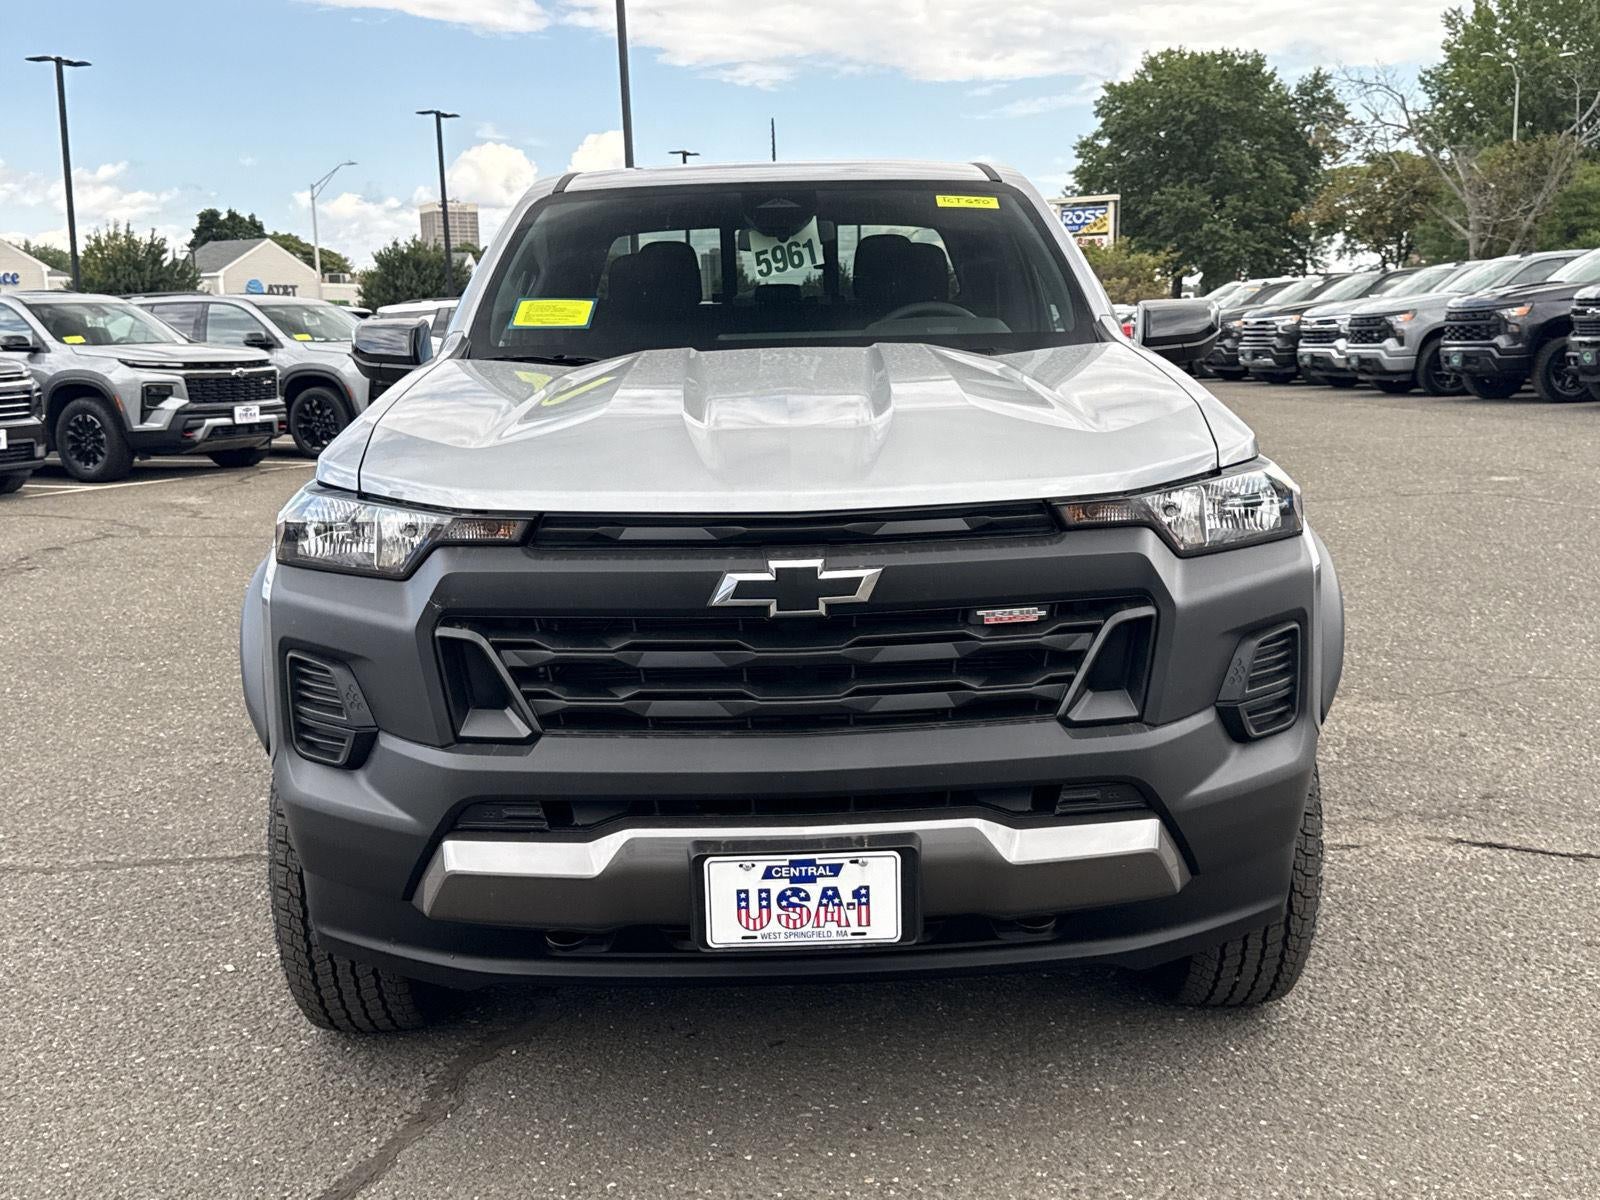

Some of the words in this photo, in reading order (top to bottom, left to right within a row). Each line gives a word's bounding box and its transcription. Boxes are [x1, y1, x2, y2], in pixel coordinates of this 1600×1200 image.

[755, 238, 817, 277] 5961
[0, 272, 20, 286] ce
[267, 284, 298, 297] AT&T
[771, 865, 834, 878] CENTRAL
[736, 885, 870, 931] USA-1
[760, 932, 782, 940] WEST
[836, 929, 849, 938] MA
